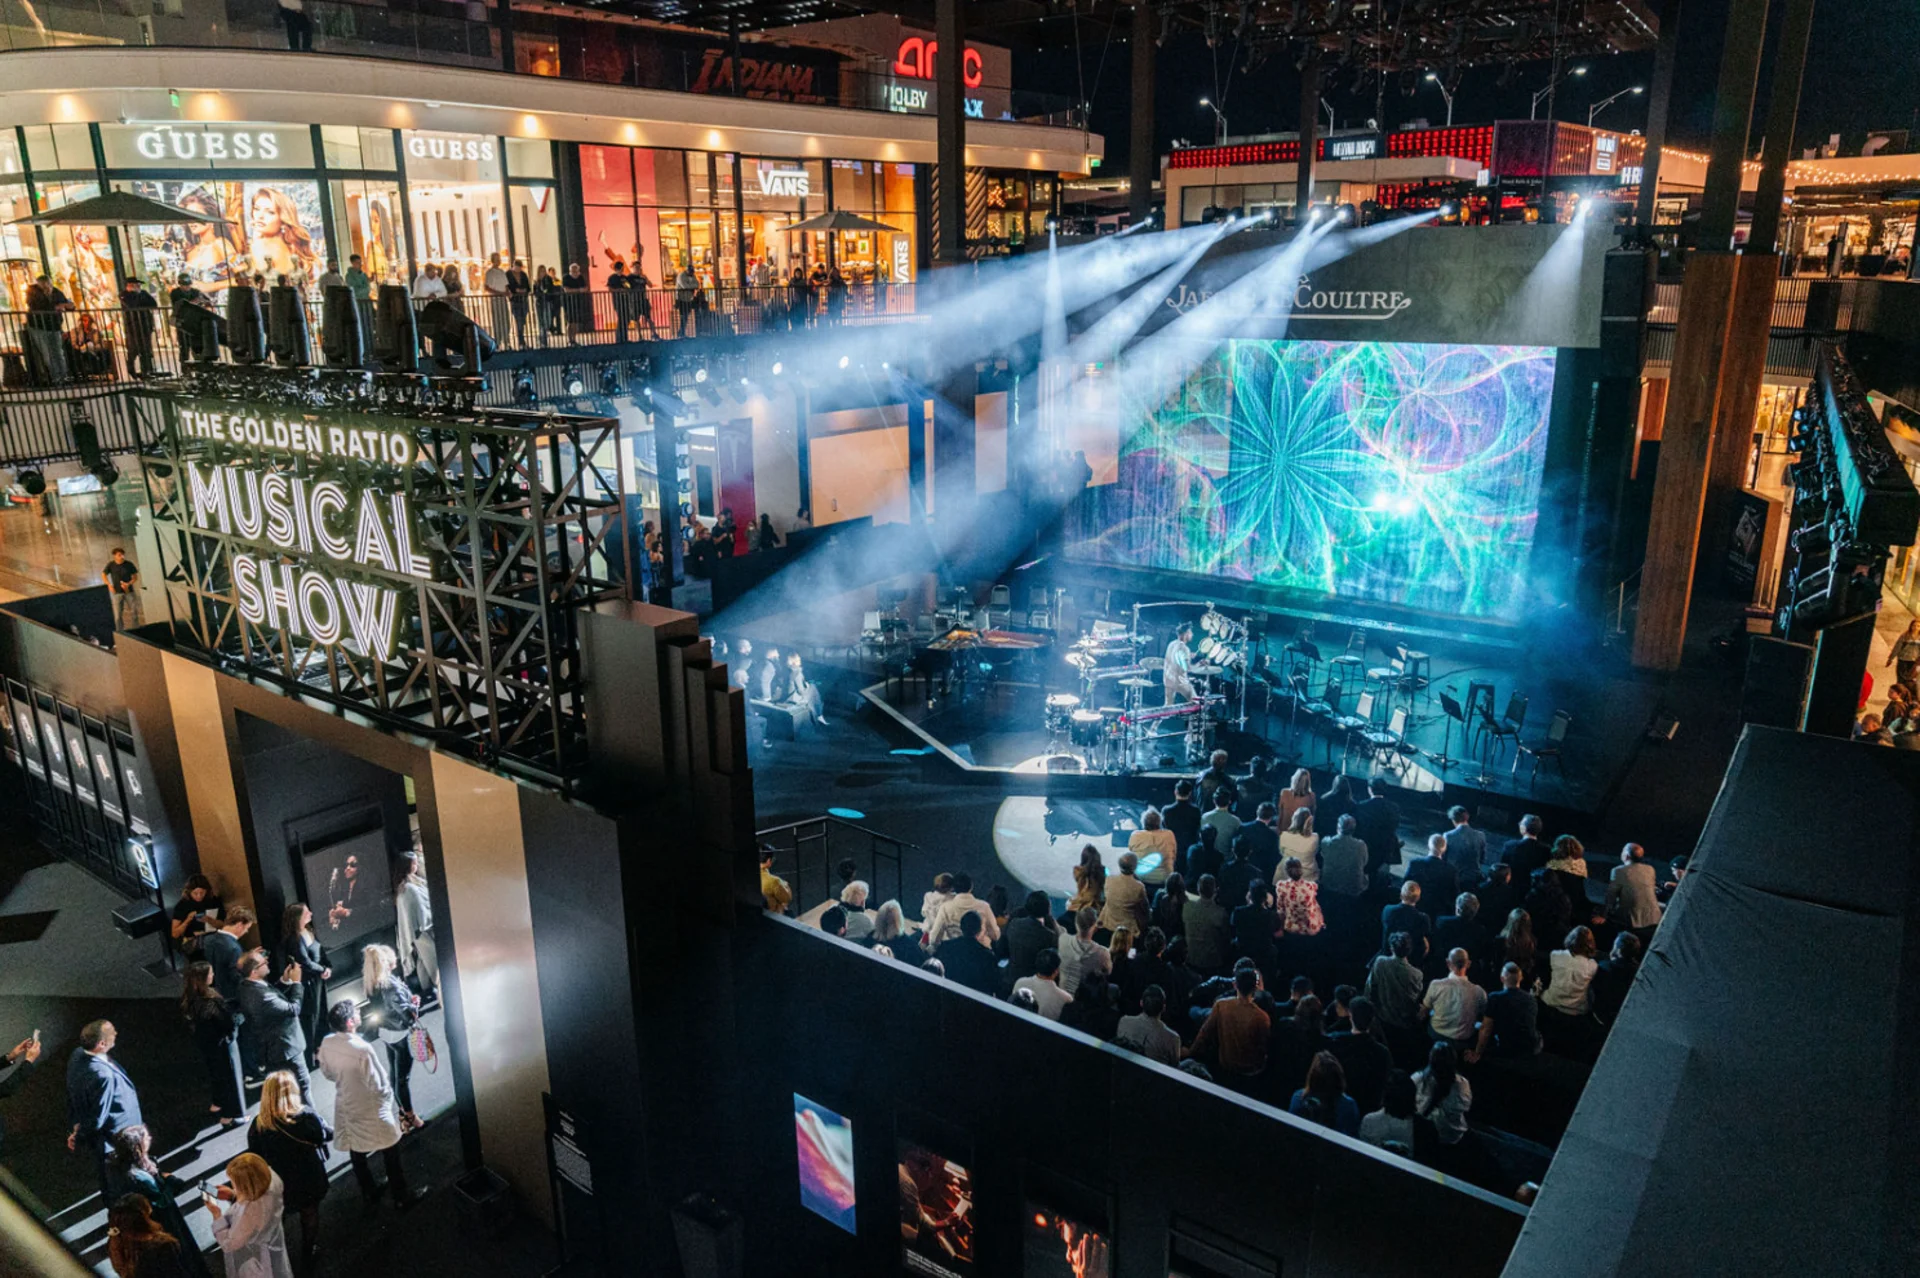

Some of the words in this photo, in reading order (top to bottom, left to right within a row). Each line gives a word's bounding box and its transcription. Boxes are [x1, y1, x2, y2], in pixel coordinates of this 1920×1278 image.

[136, 131, 280, 161] GUESS
[407, 136, 495, 162] GUESS
[757, 169, 810, 198] VANS
[893, 239, 910, 287] VANS
[181, 410, 225, 441] THE
[228, 415, 323, 453] GOLDEN
[329, 426, 410, 465] RATIO
[187, 460, 432, 579] MUSICAL
[233, 554, 398, 663] SHOW
